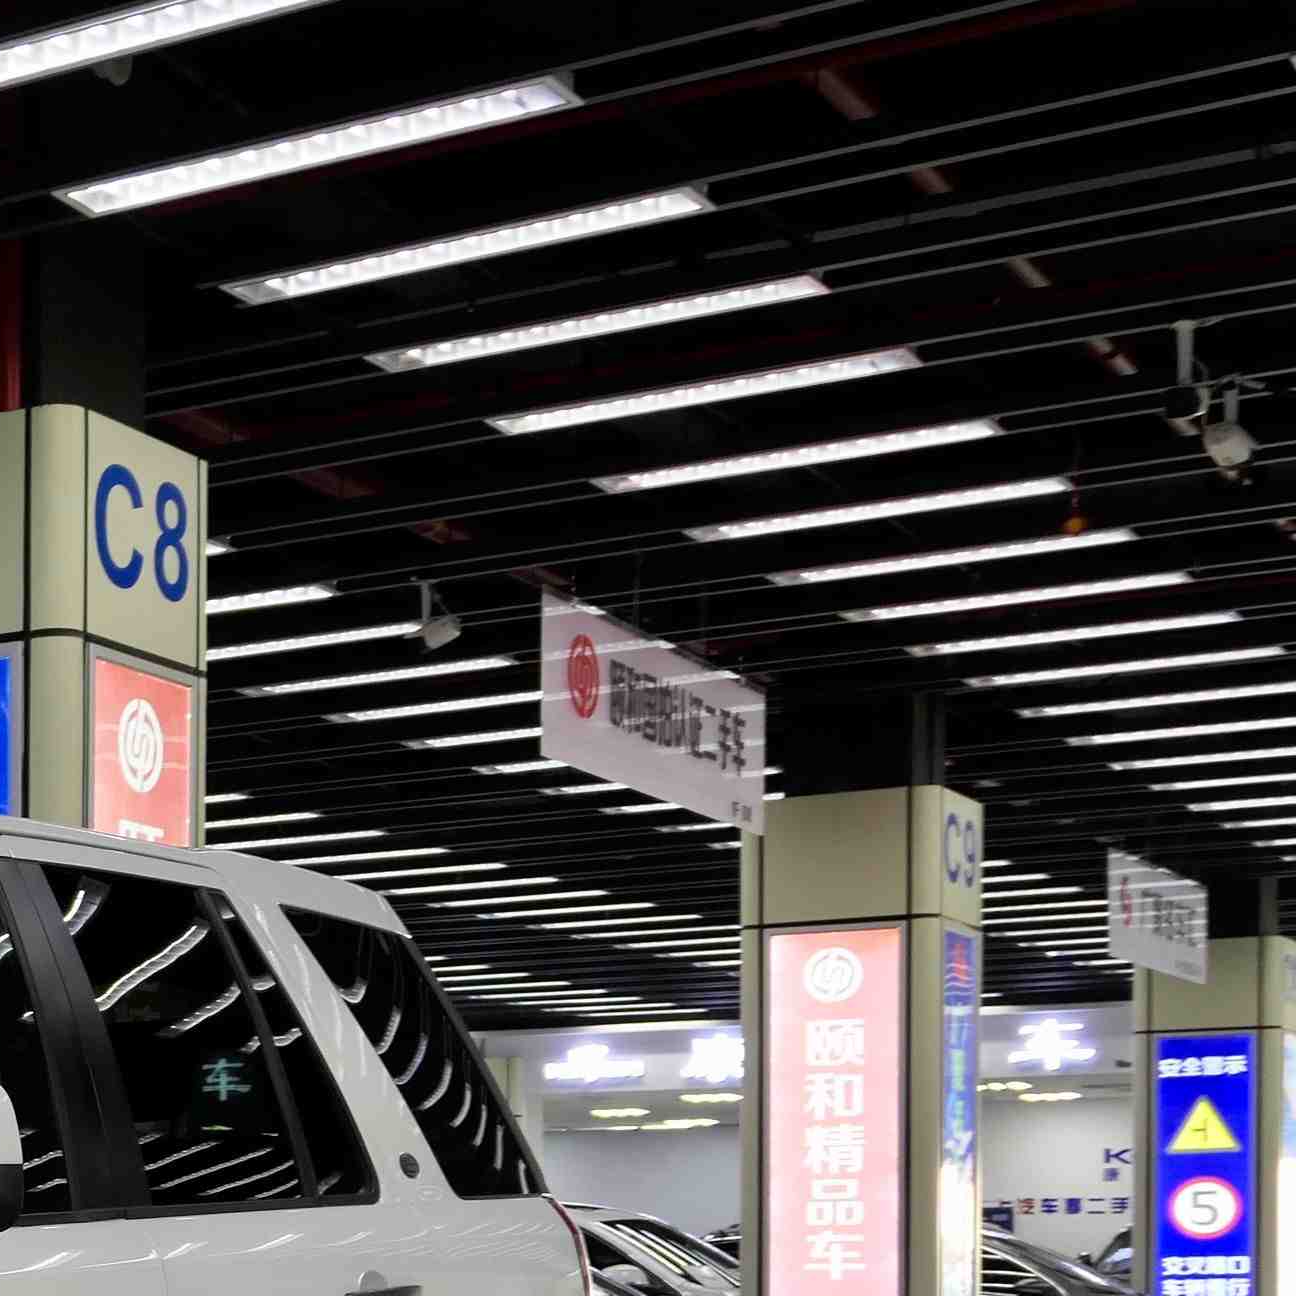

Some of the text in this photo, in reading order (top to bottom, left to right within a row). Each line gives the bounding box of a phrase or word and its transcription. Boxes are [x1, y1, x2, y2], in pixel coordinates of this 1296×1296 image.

[95, 463, 189, 602] C8
[944, 812, 977, 888] C9
[1191, 1190, 1219, 1226] 5
